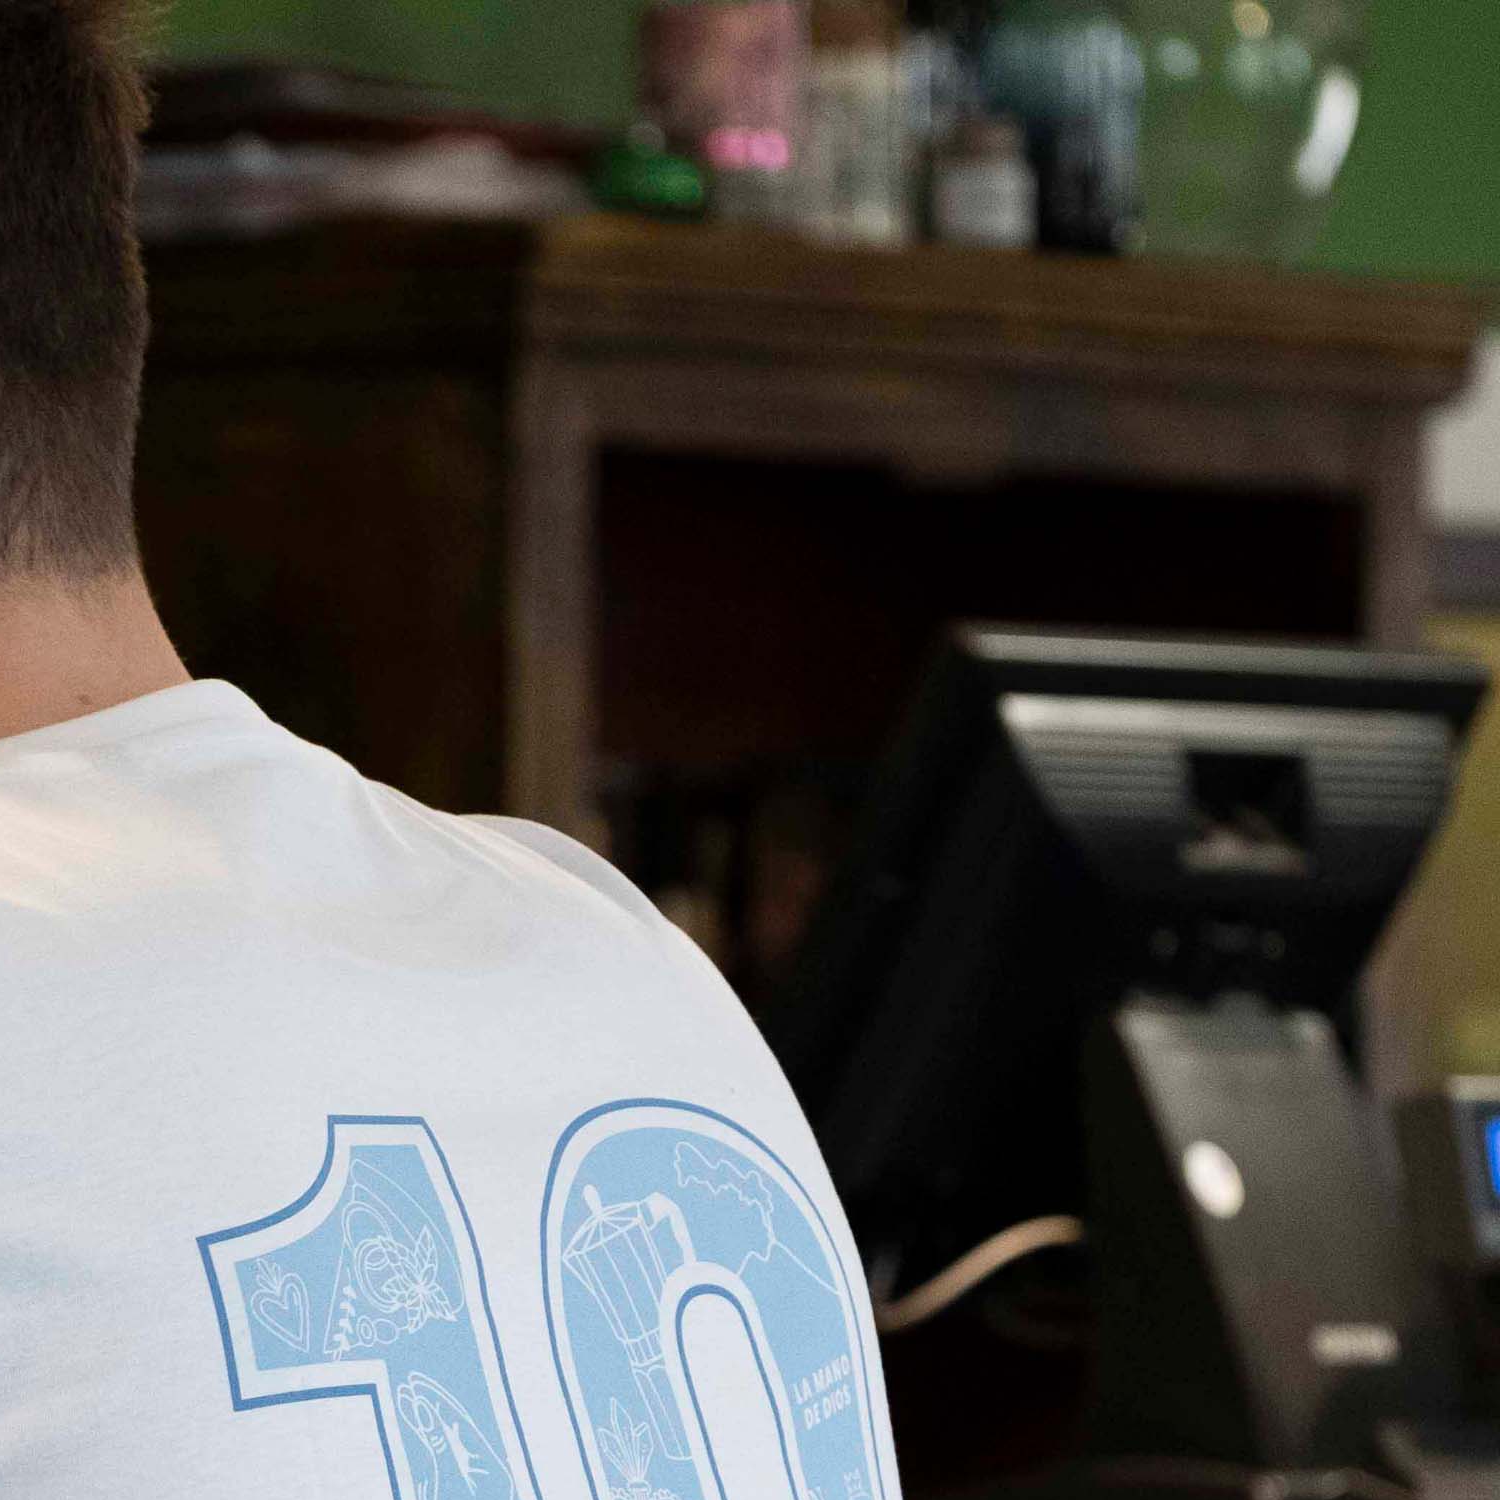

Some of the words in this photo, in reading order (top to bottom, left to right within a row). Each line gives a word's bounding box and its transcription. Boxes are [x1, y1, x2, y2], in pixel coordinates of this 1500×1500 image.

[794, 1377, 812, 1405] LA
[812, 1354, 850, 1393] MANO
[804, 1403, 821, 1431] DE
[822, 1385, 851, 1420] DIOS
